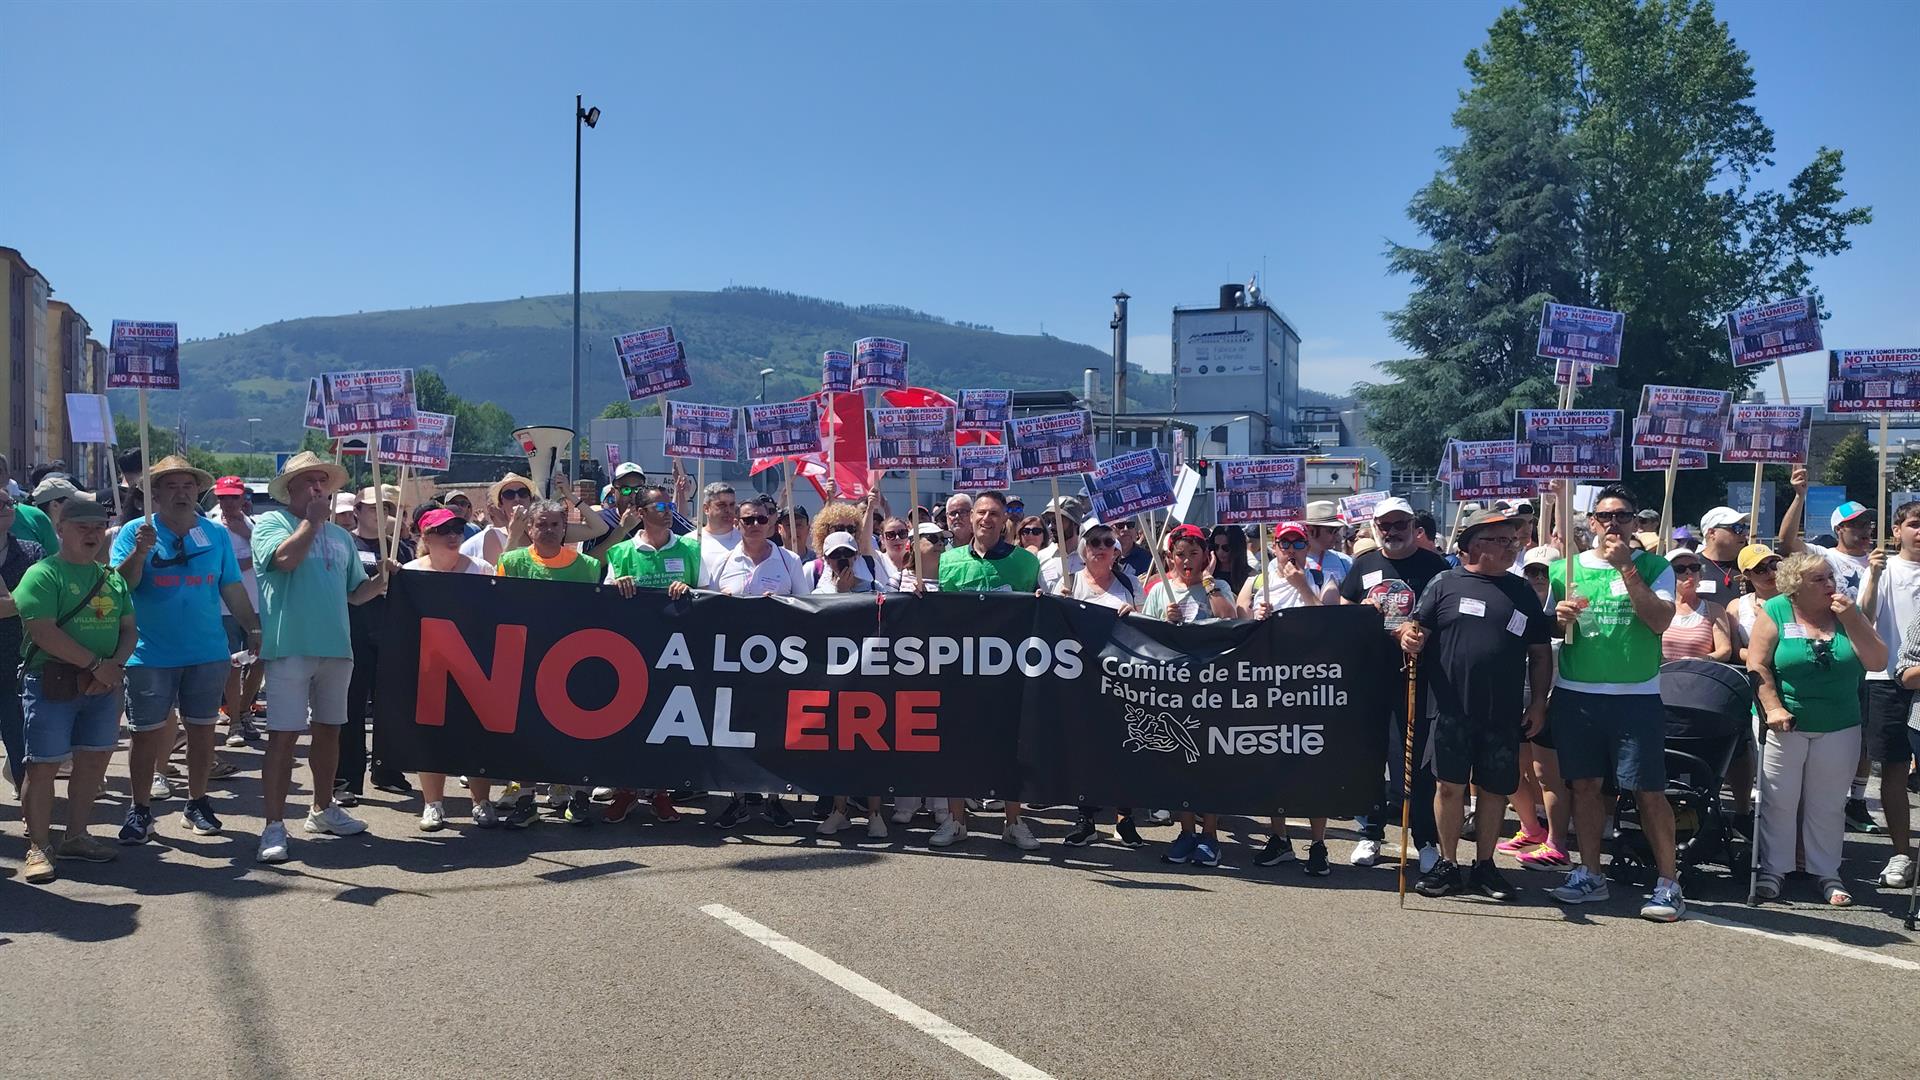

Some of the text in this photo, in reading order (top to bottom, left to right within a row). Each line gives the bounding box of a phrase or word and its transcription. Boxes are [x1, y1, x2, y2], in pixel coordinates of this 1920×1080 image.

[1554, 310, 1569, 319] NO
[1739, 314, 1755, 323] NO
[1568, 349, 1580, 357] AL
[1766, 347, 1779, 357] AL
[1845, 356, 1863, 364] NO
[130, 374, 146, 384] AL
[335, 378, 351, 388] NO
[1654, 393, 1669, 401] NO
[1840, 399, 1864, 408] ¡NO
[1867, 399, 1883, 408] AL
[677, 408, 689, 417] NO
[754, 410, 768, 419] NO
[417, 416, 445, 427] MEROS
[879, 415, 895, 423] NO
[1531, 416, 1550, 426] NO
[360, 419, 375, 430] AL
[1017, 423, 1034, 434] NO
[1643, 434, 1664, 443] ¡NO
[1665, 435, 1680, 444] AL
[690, 446, 703, 454] AL
[776, 444, 788, 453] AL
[1462, 446, 1515, 458] NO NÚMER
[397, 451, 411, 462] AL
[1730, 450, 1749, 458] ¡NO
[1751, 450, 1765, 459] AL
[879, 457, 899, 466] ¡NO
[901, 457, 915, 465] AL
[1678, 458, 1693, 466] RE!
[1020, 465, 1041, 476] ¡NO
[1043, 463, 1057, 473] AL
[1094, 466, 1110, 478] NO
[1227, 466, 1245, 476] NO
[1526, 464, 1551, 474] ¡NO
[1553, 464, 1571, 473] AL
[974, 479, 984, 487] AL
[1460, 489, 1482, 498] ¡NO
[1483, 487, 1498, 496] AL
[1128, 501, 1140, 511] AL
[1227, 510, 1248, 520] ¡NO
[1251, 509, 1265, 519] AL
[655, 632, 1083, 680] A LOS DESPIDOS
[1101, 656, 1343, 687] Comité de Empresa
[415, 617, 649, 740] NO
[1100, 676, 1349, 710] Fábrica de La Penilla
[645, 685, 941, 751] AL ERE
